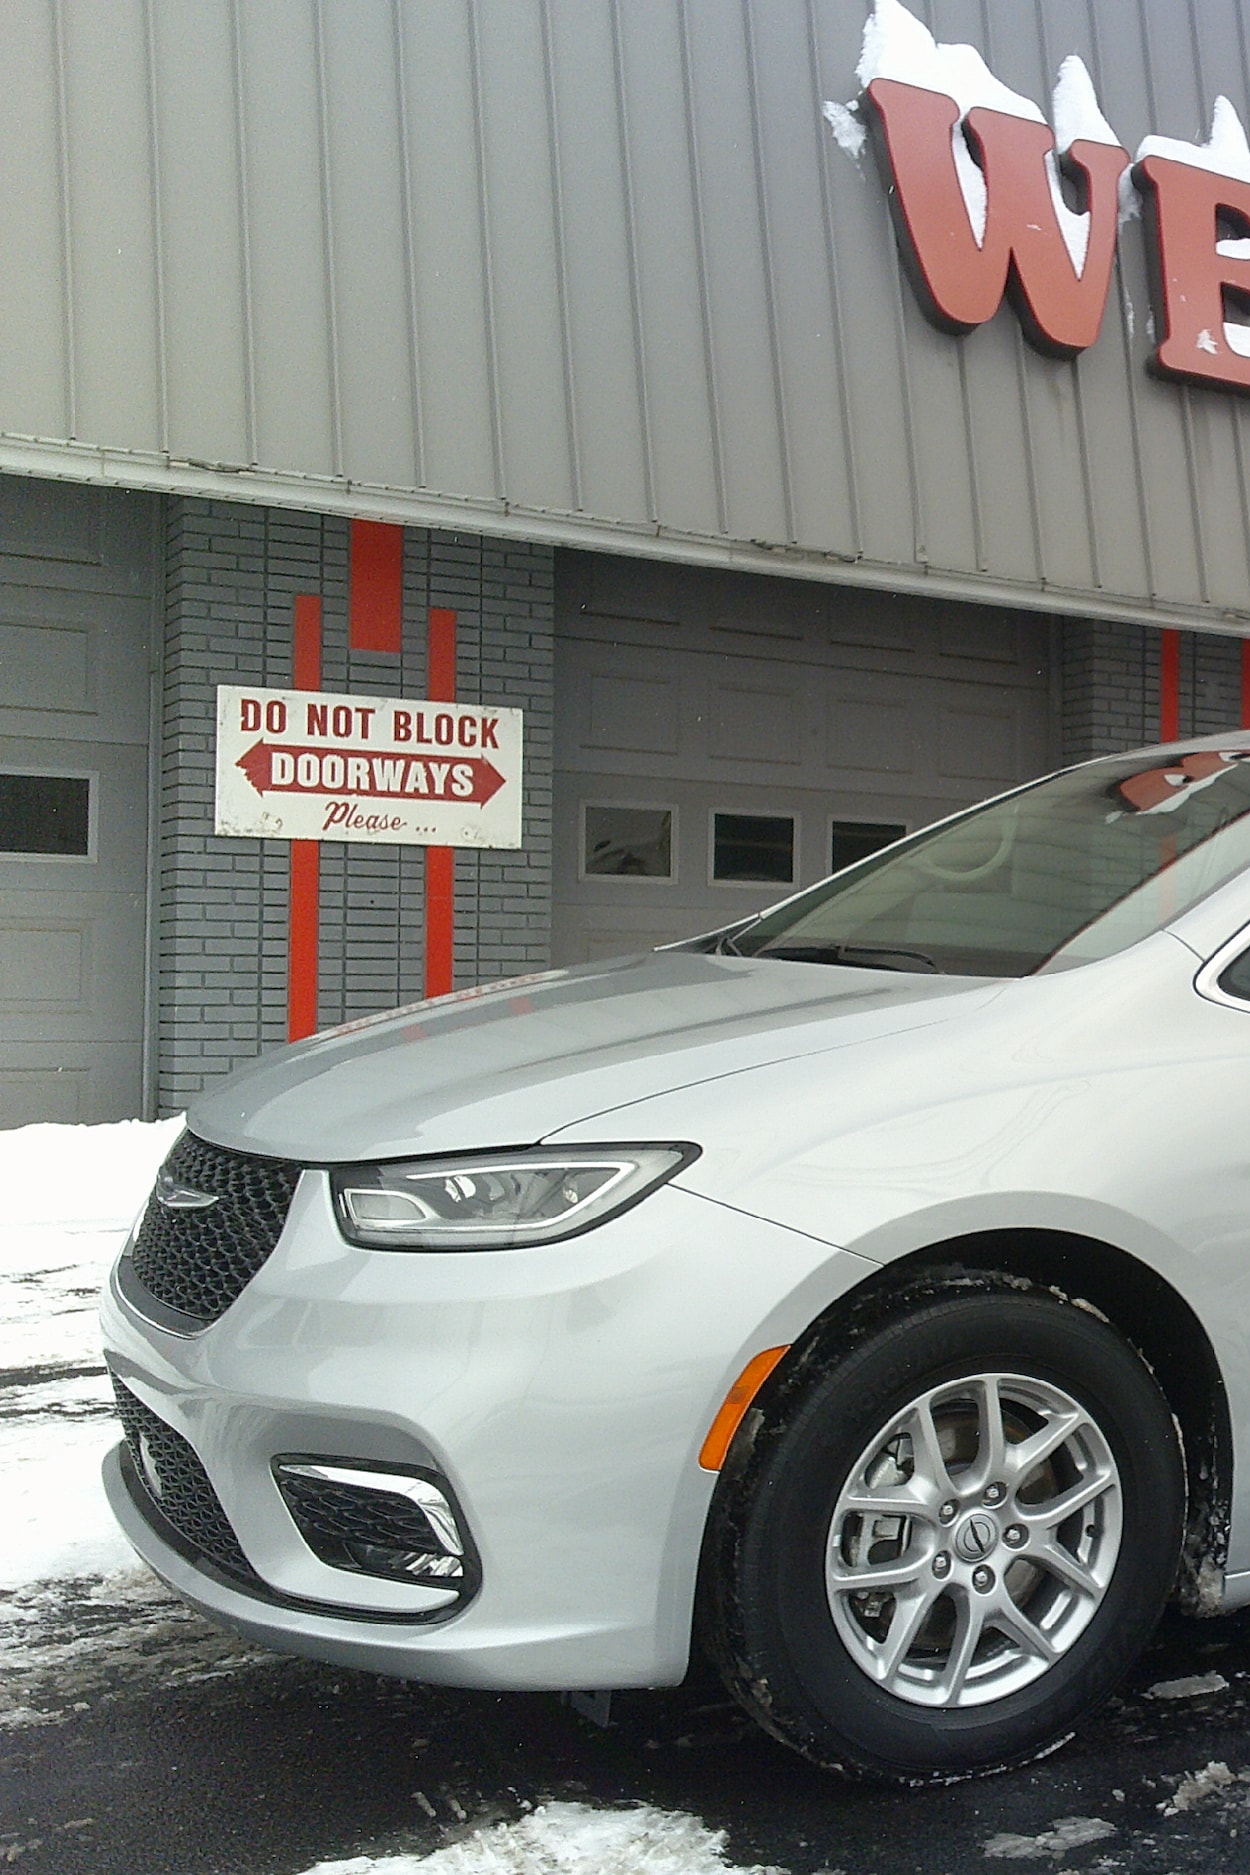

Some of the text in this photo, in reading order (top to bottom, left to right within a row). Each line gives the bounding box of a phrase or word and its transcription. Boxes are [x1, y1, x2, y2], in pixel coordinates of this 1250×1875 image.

[240, 698, 500, 750] DO NOT BLOCK
[270, 751, 475, 797] DOORWAYS
